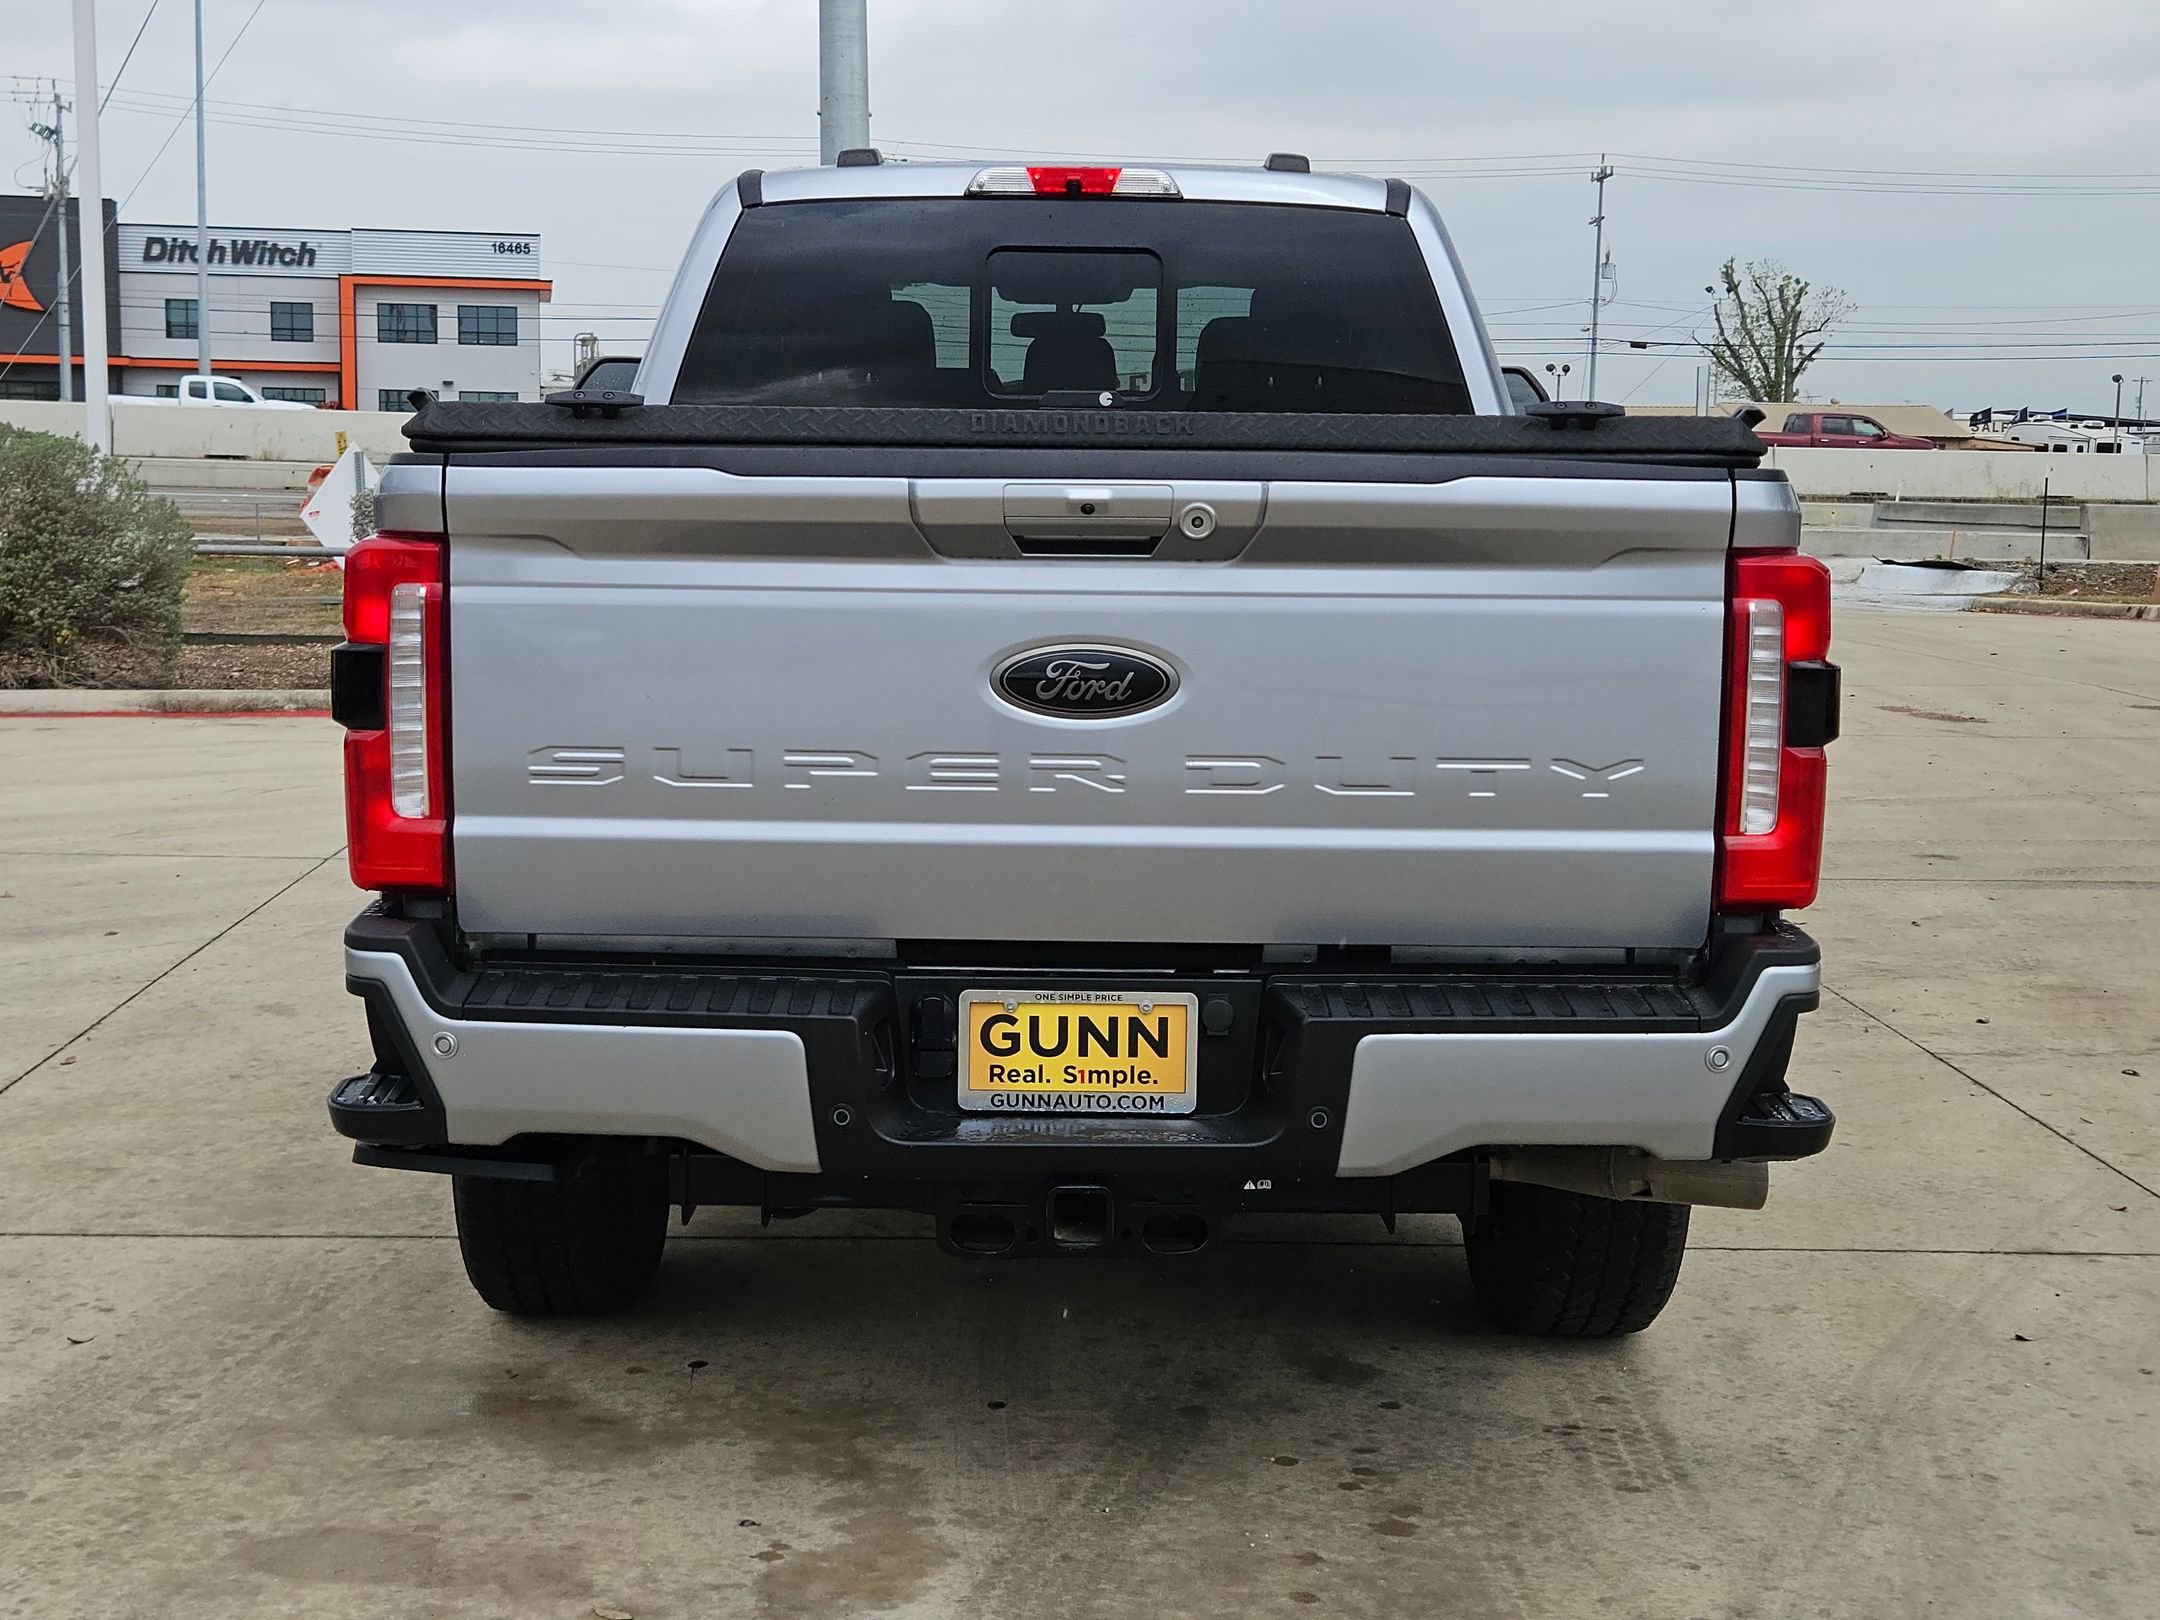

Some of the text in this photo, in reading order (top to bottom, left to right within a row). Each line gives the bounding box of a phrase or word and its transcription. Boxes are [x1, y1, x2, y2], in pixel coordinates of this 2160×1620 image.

[230, 238, 317, 268] Witch
[491, 241, 531, 255] 16465
[970, 412, 1194, 436] DIAMONDBACK
[1035, 660, 1135, 701] Ford
[528, 745, 1645, 799] SUPER DUTY
[1034, 993, 1123, 1002] ONE SIMPLE PRICE
[979, 1013, 1169, 1059] GUNN
[988, 1064, 1051, 1084] Real.
[990, 1093, 1165, 1111] GUNNAUTO.COM
